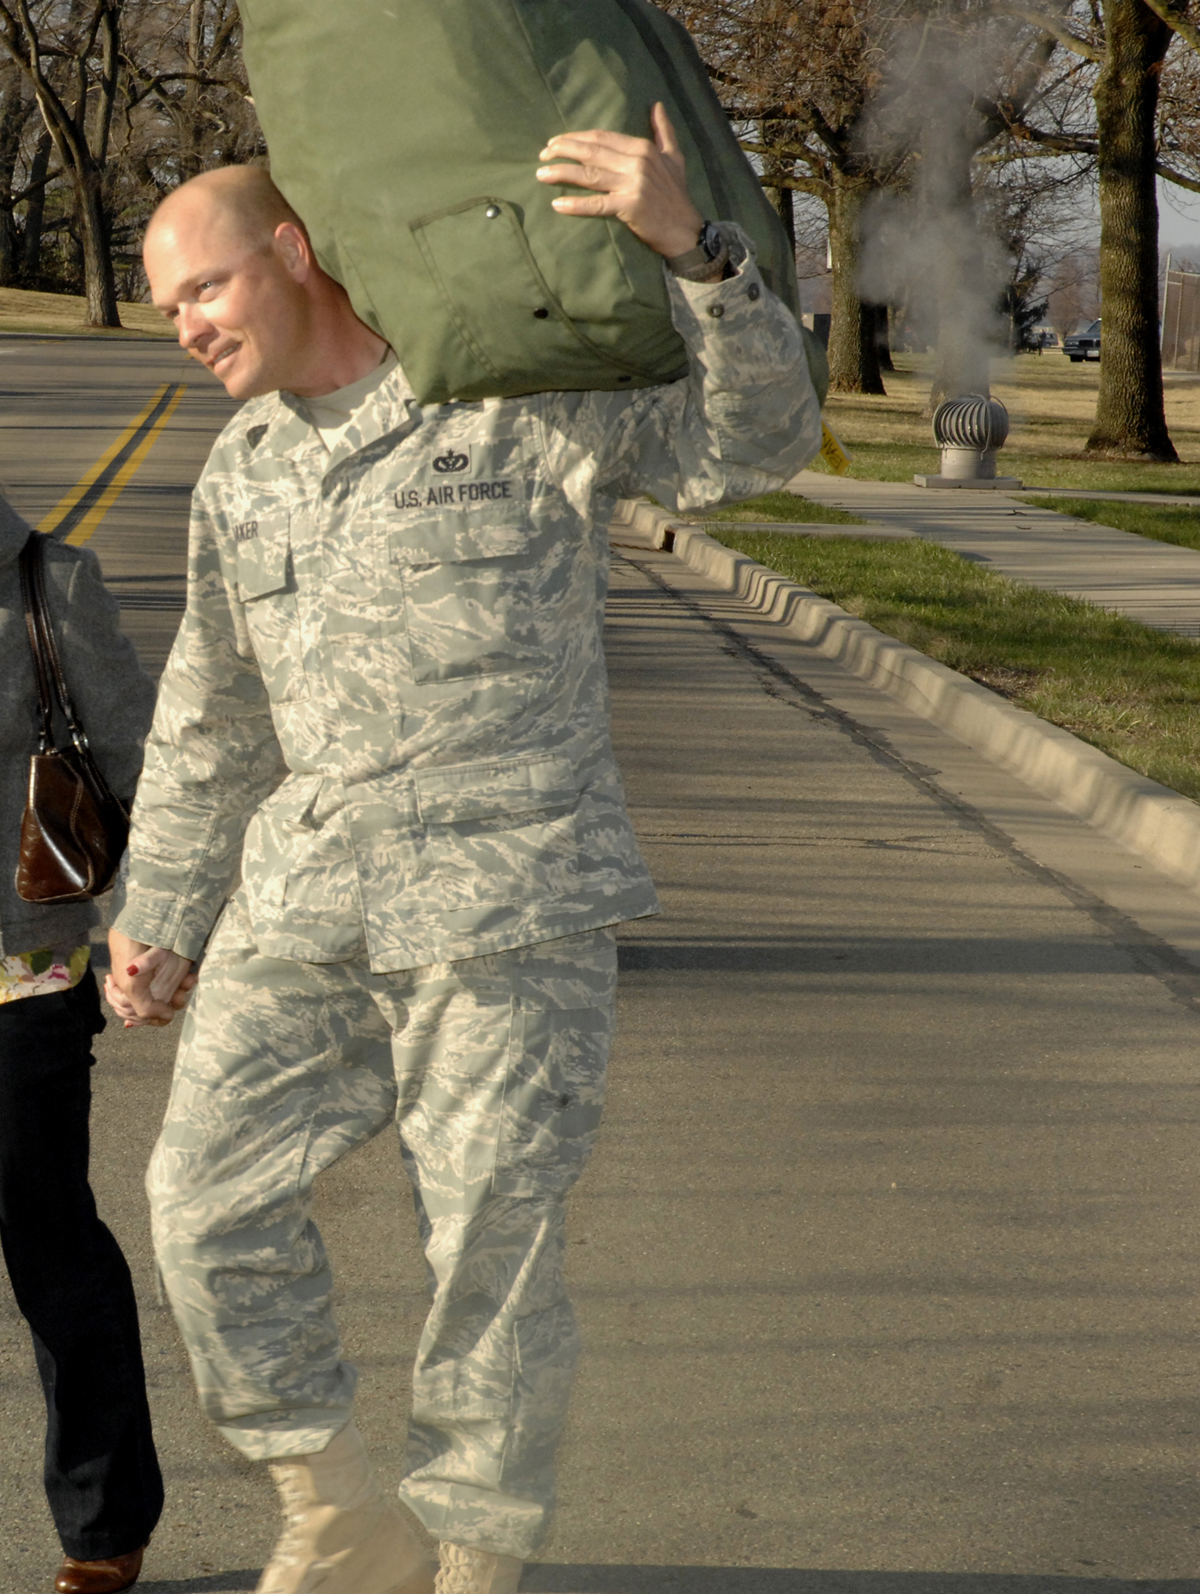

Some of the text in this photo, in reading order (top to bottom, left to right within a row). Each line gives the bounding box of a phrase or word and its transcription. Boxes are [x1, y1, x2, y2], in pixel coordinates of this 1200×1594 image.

[394, 480, 513, 509] U.S. AIR FORCE
